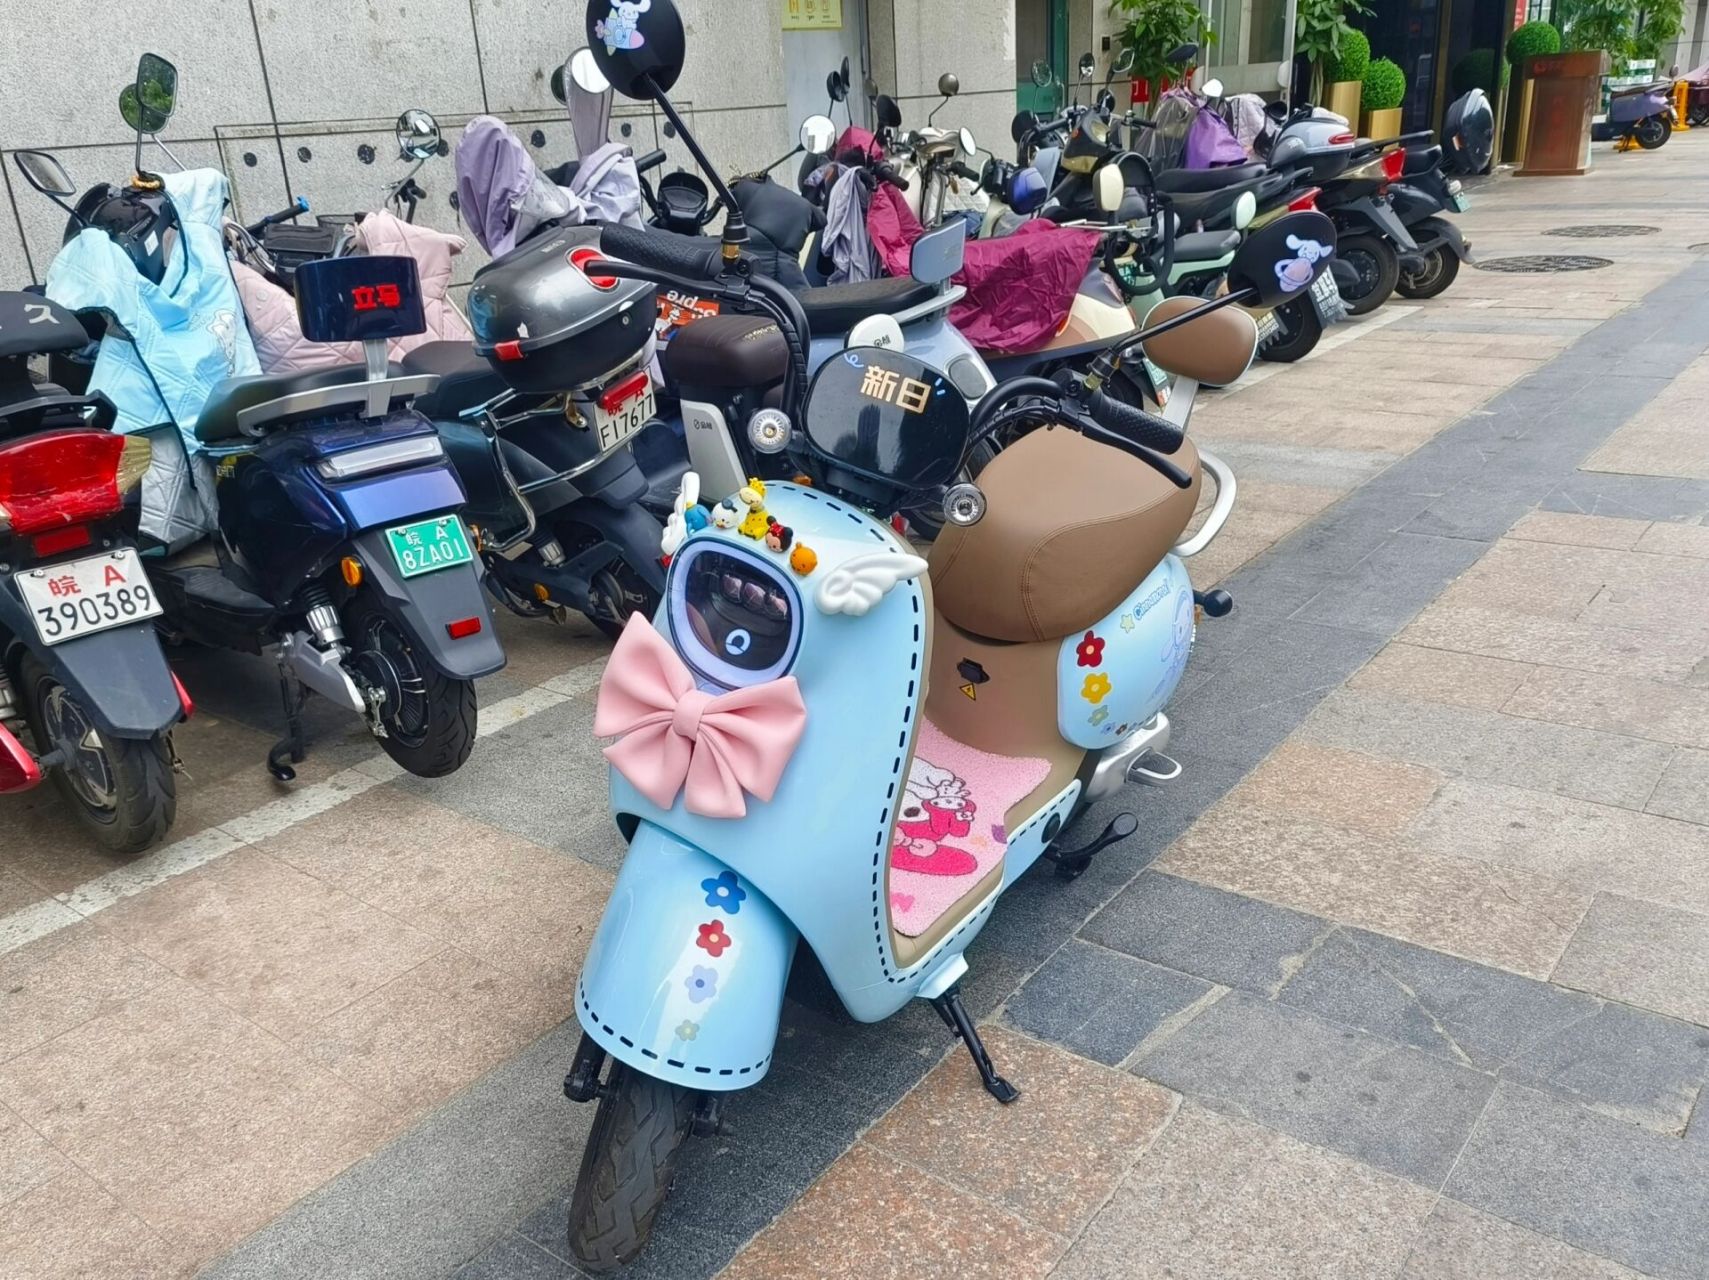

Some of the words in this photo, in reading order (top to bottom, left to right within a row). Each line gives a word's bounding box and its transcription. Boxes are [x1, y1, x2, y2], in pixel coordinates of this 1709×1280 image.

[352, 284, 400, 310] 立马
[860, 365, 931, 414] 新日
[600, 393, 653, 448] F17677
[405, 531, 423, 546] 皖
[435, 525, 449, 540] A
[402, 538, 464, 570] 8ZA01
[48, 575, 82, 597] 皖
[103, 564, 126, 587] A
[38, 584, 151, 636] 390389
